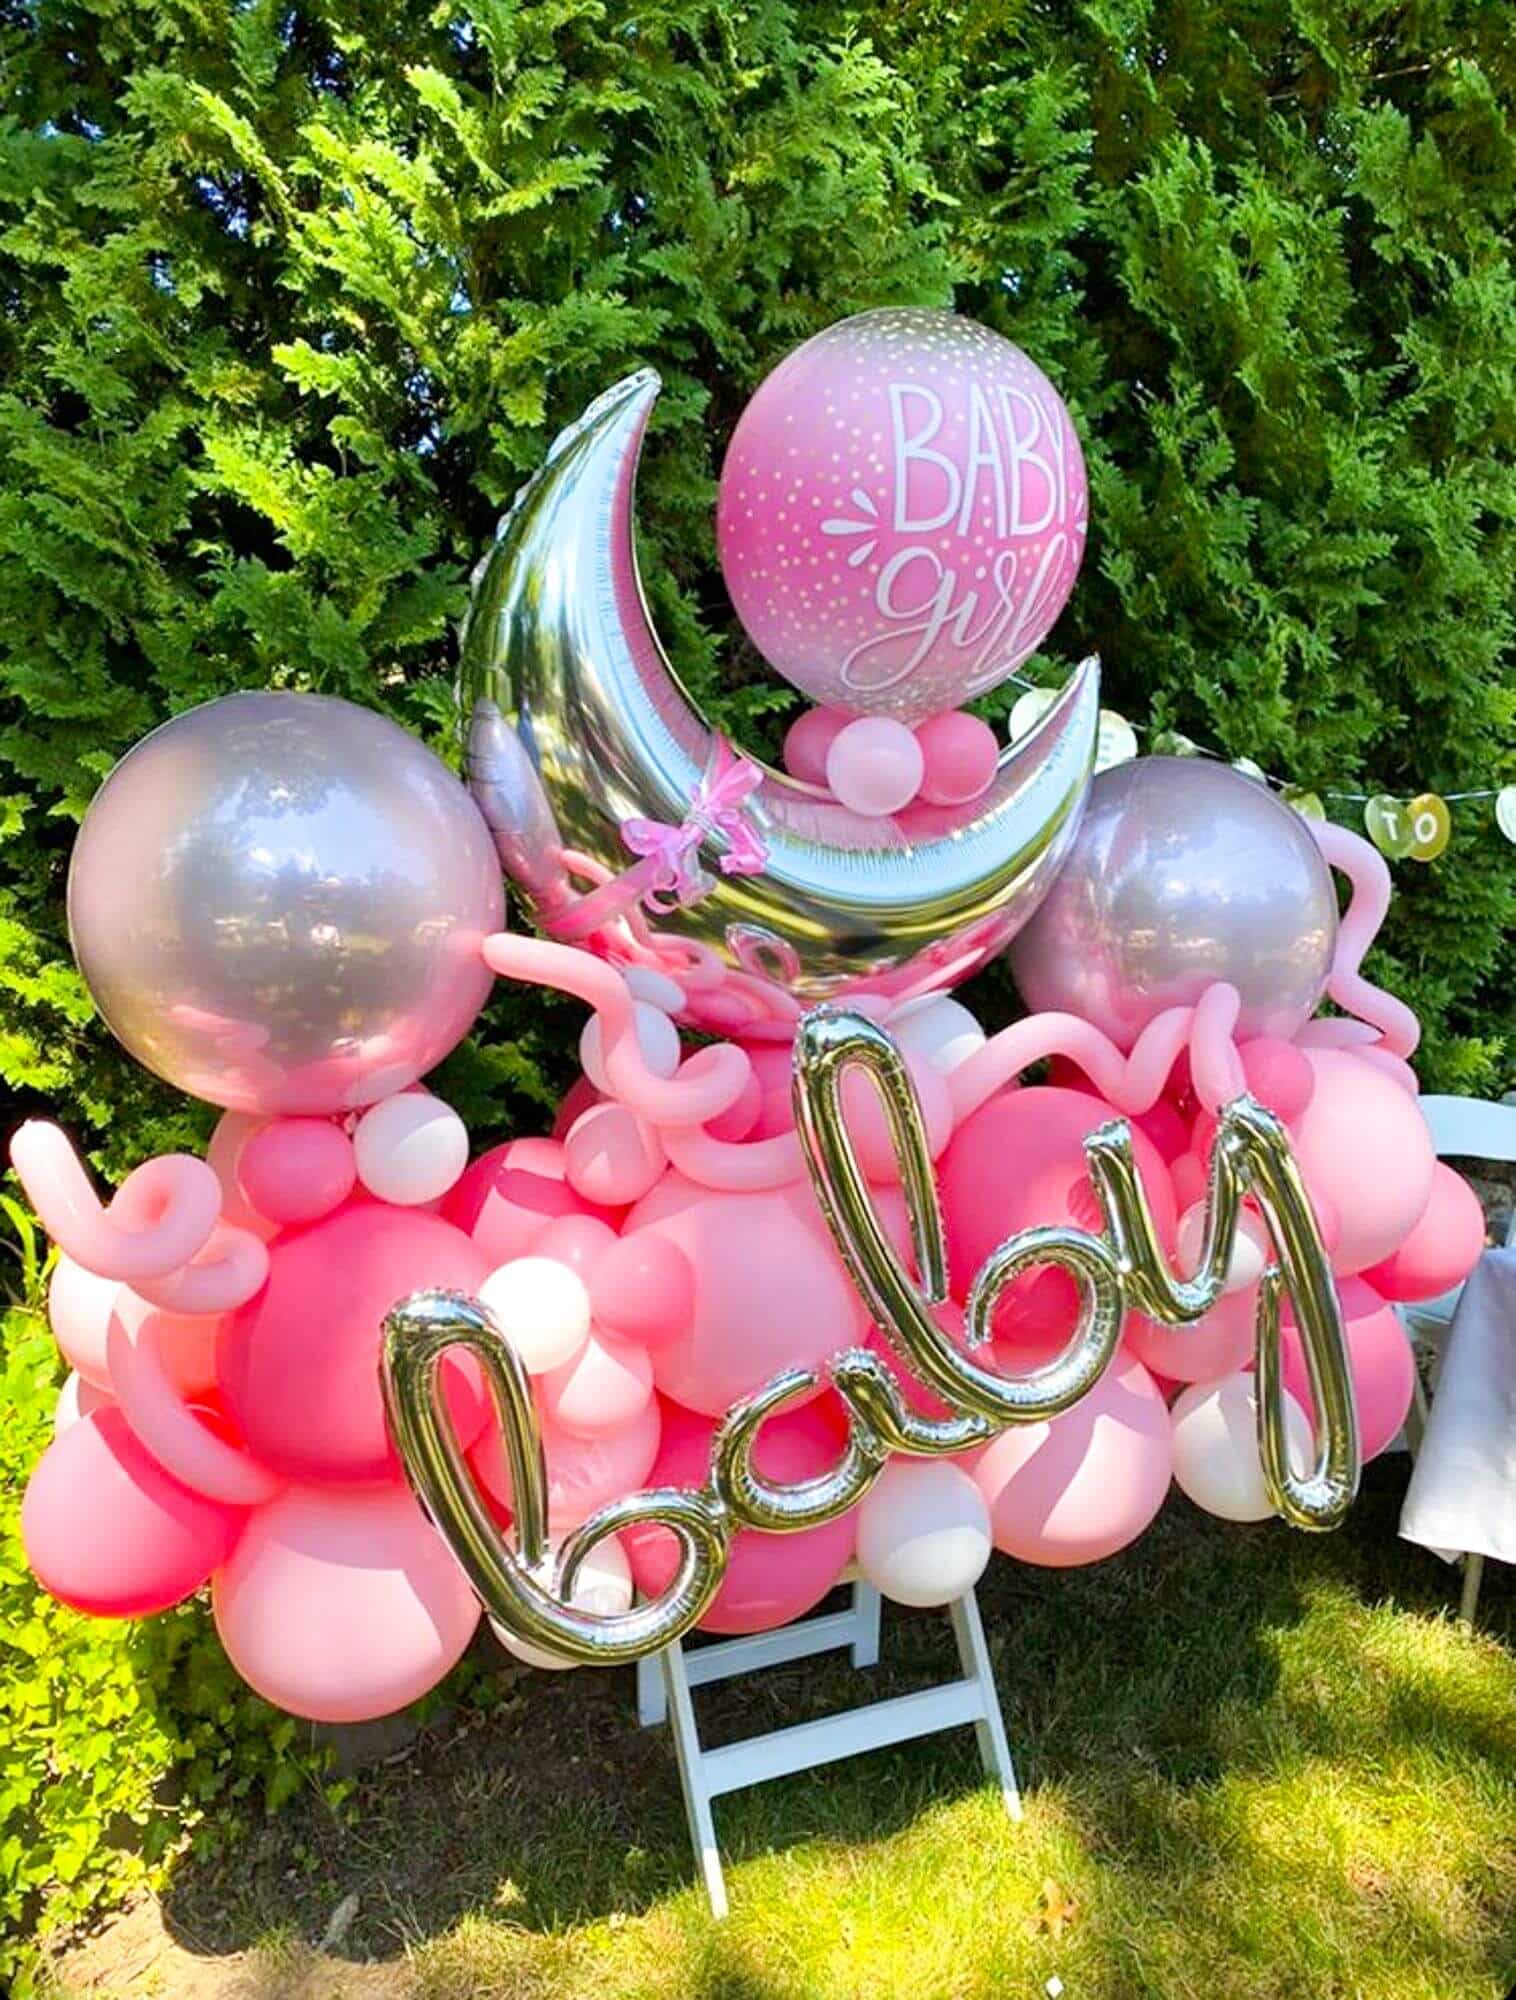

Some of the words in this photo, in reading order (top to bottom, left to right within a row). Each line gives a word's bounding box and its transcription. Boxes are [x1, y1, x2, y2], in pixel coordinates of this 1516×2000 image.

[888, 382, 1067, 538] BABY
[839, 532, 1068, 691] girl
[1381, 811, 1438, 843] TO
[381, 1004, 1361, 1664] baby
